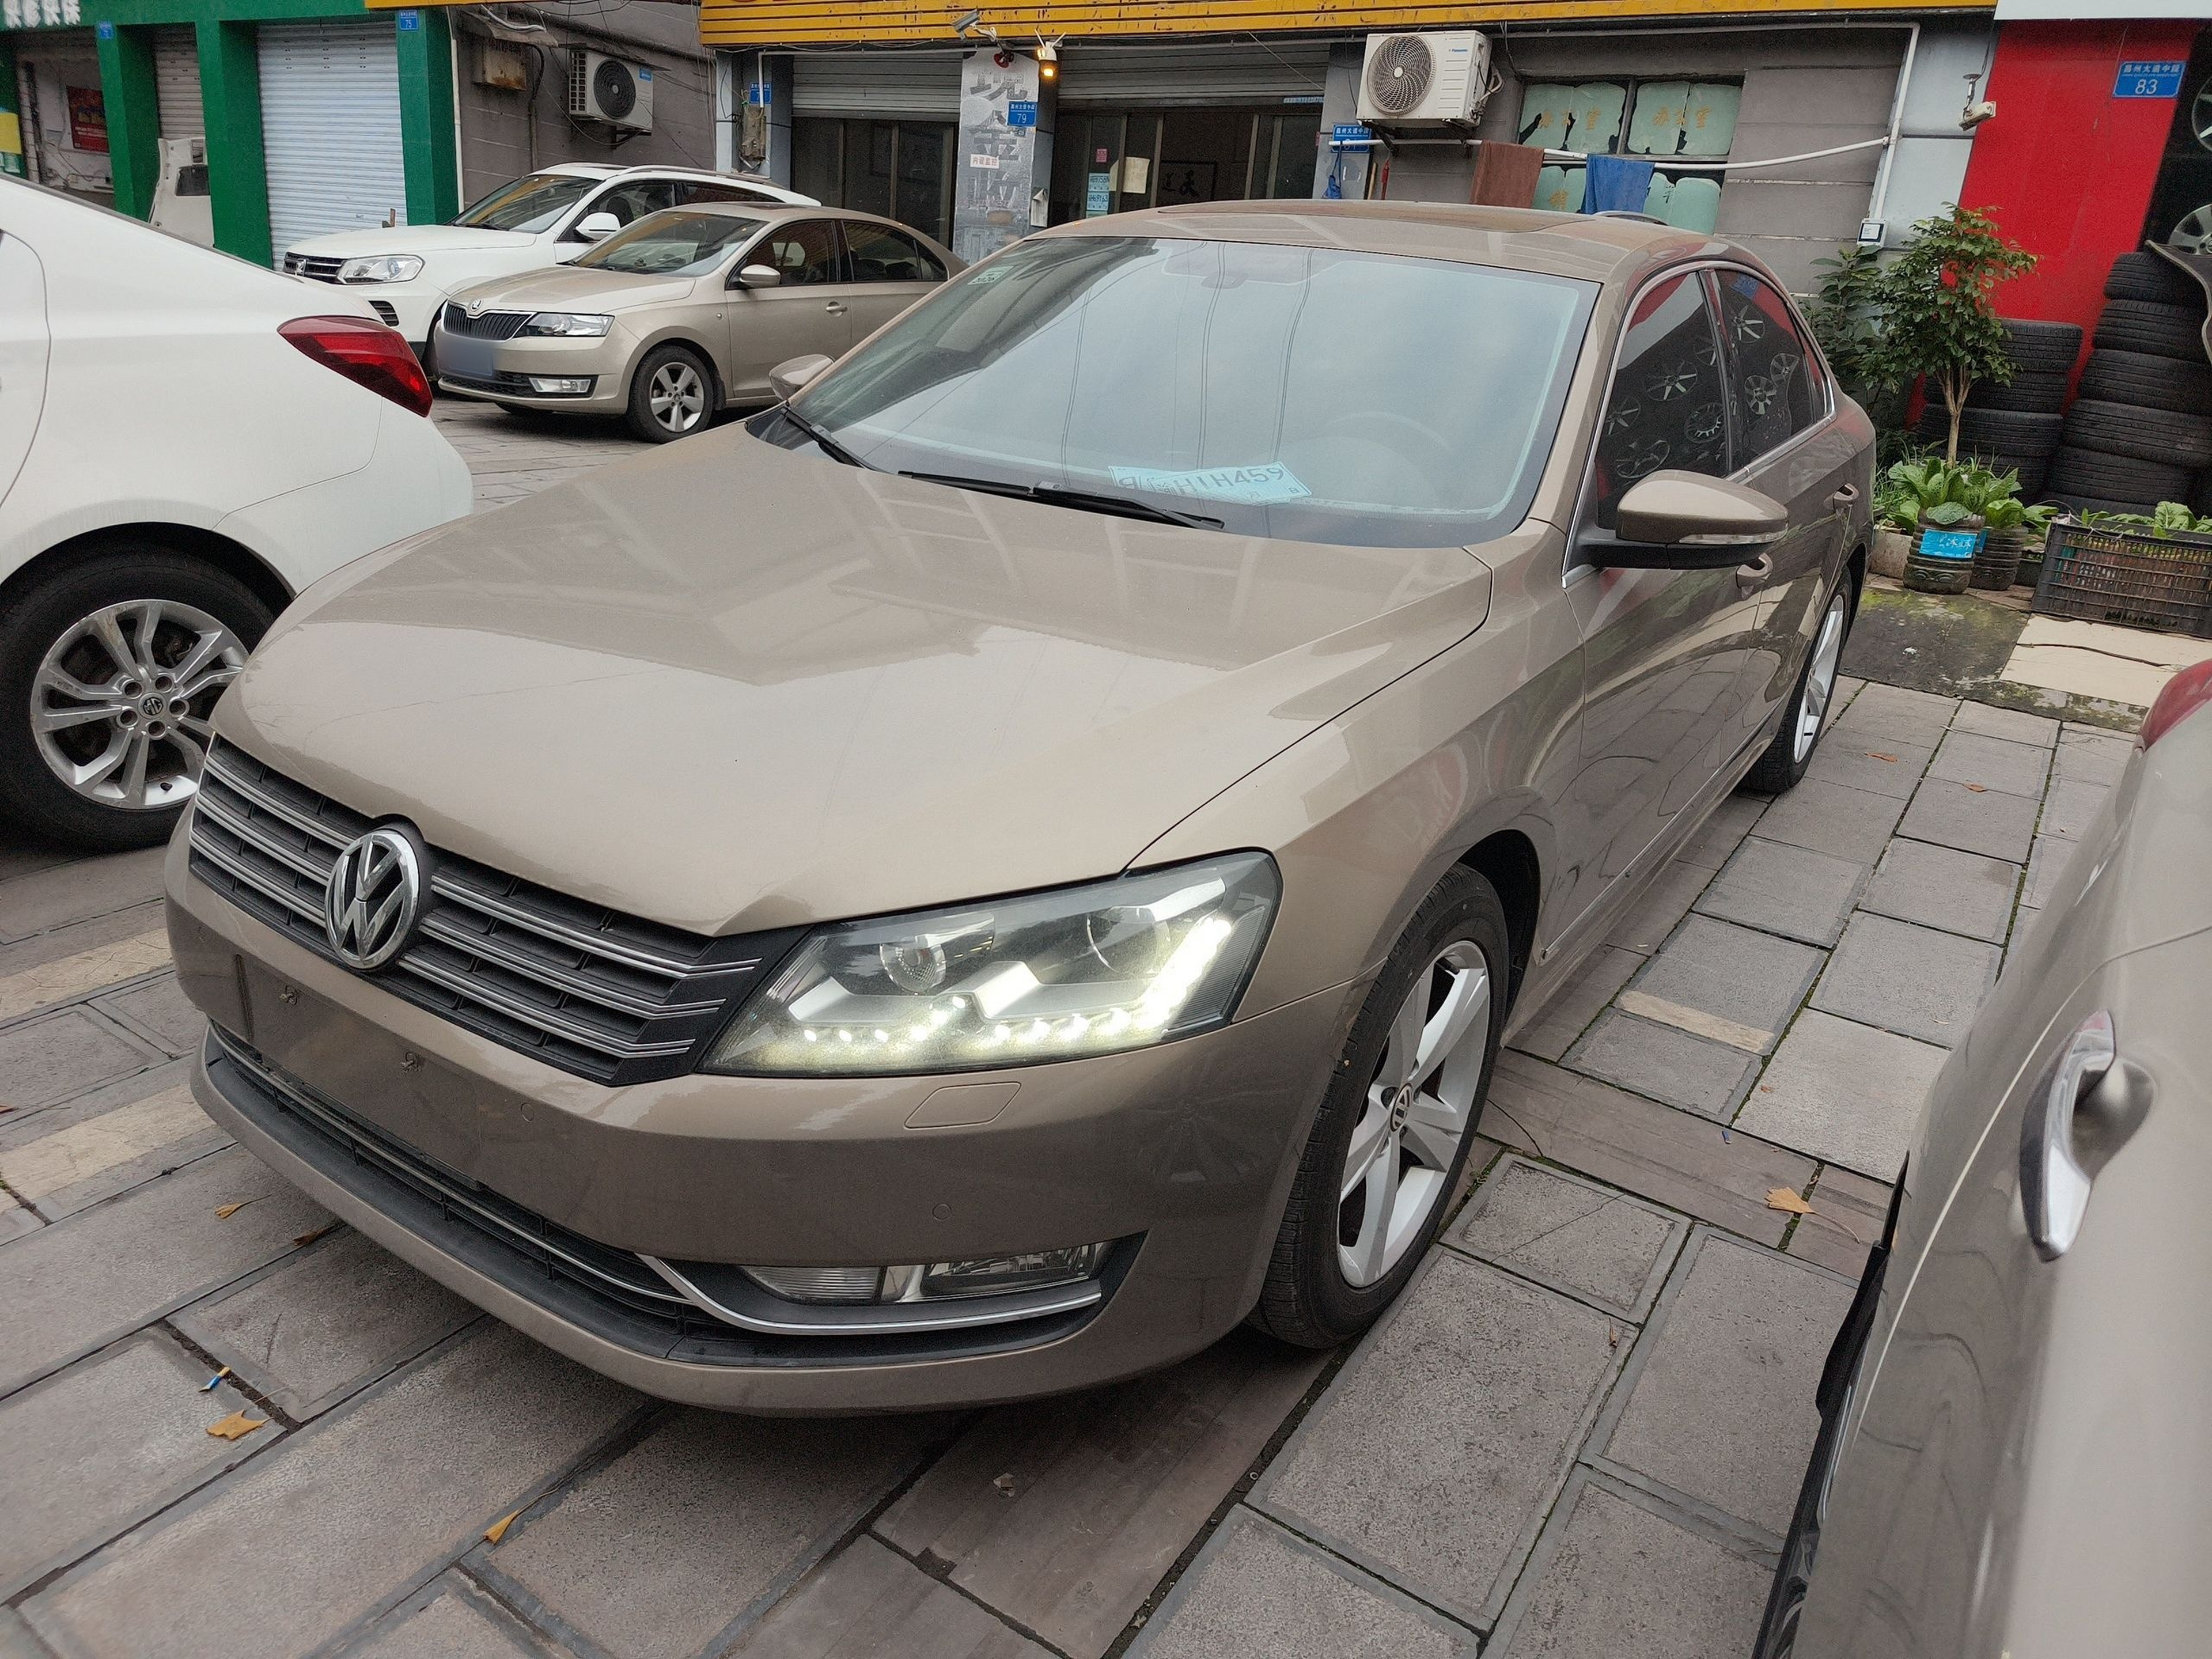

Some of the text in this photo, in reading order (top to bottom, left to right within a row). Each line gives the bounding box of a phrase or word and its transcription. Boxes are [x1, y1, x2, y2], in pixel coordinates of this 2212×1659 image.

[405, 19, 412, 28] 75
[2134, 78, 2158, 94] 83
[1017, 113, 1027, 124] 79
